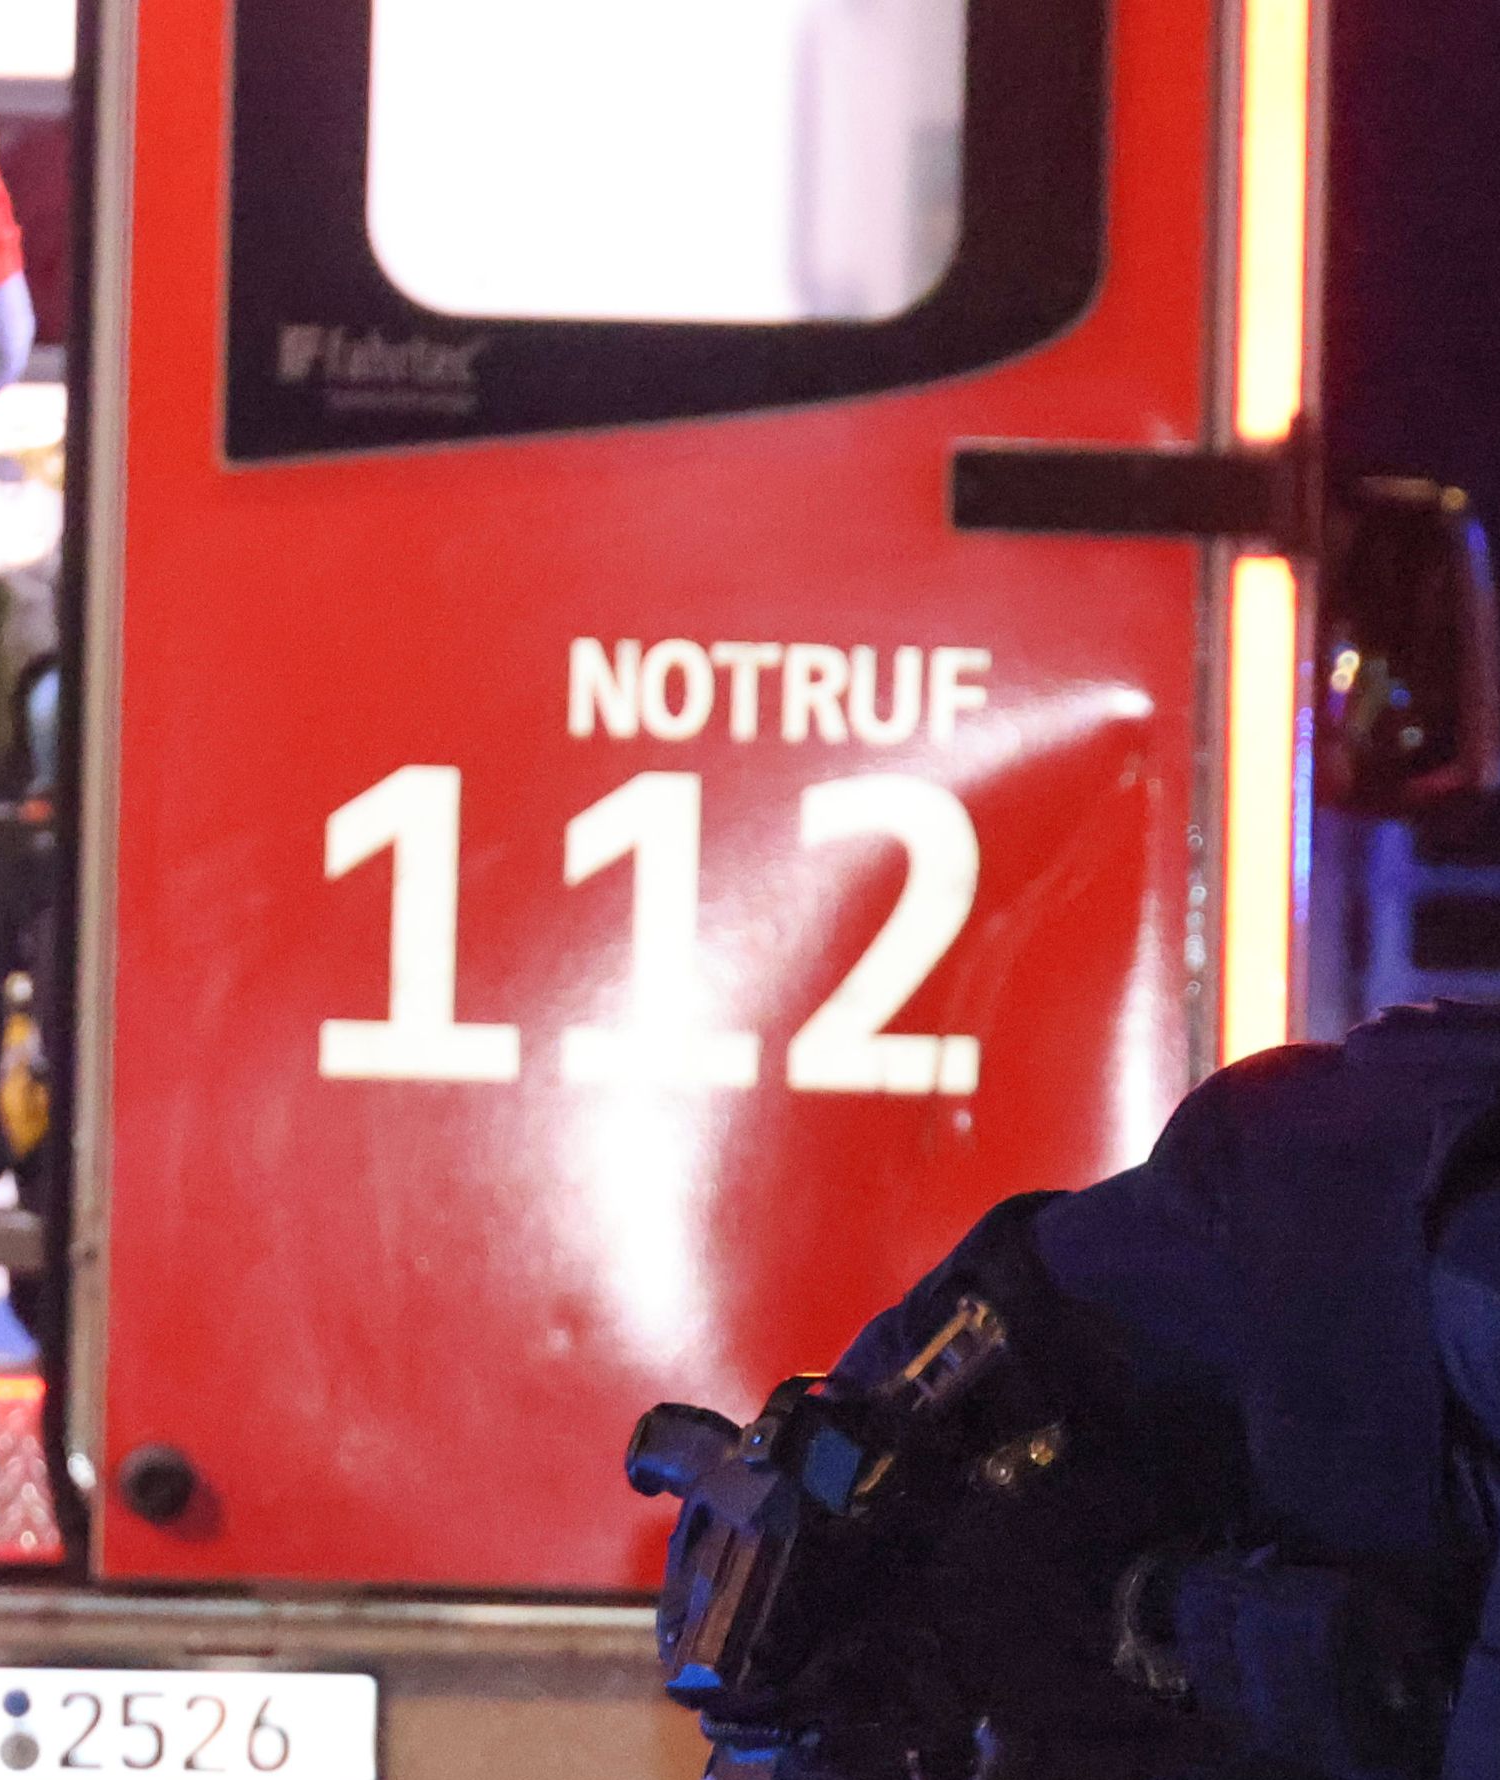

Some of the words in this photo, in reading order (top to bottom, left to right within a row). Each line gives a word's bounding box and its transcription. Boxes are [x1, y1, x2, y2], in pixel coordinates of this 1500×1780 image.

[566, 637, 992, 744] NOTRUF
[317, 764, 984, 1096] 112
[58, 1691, 292, 1774] 2526
